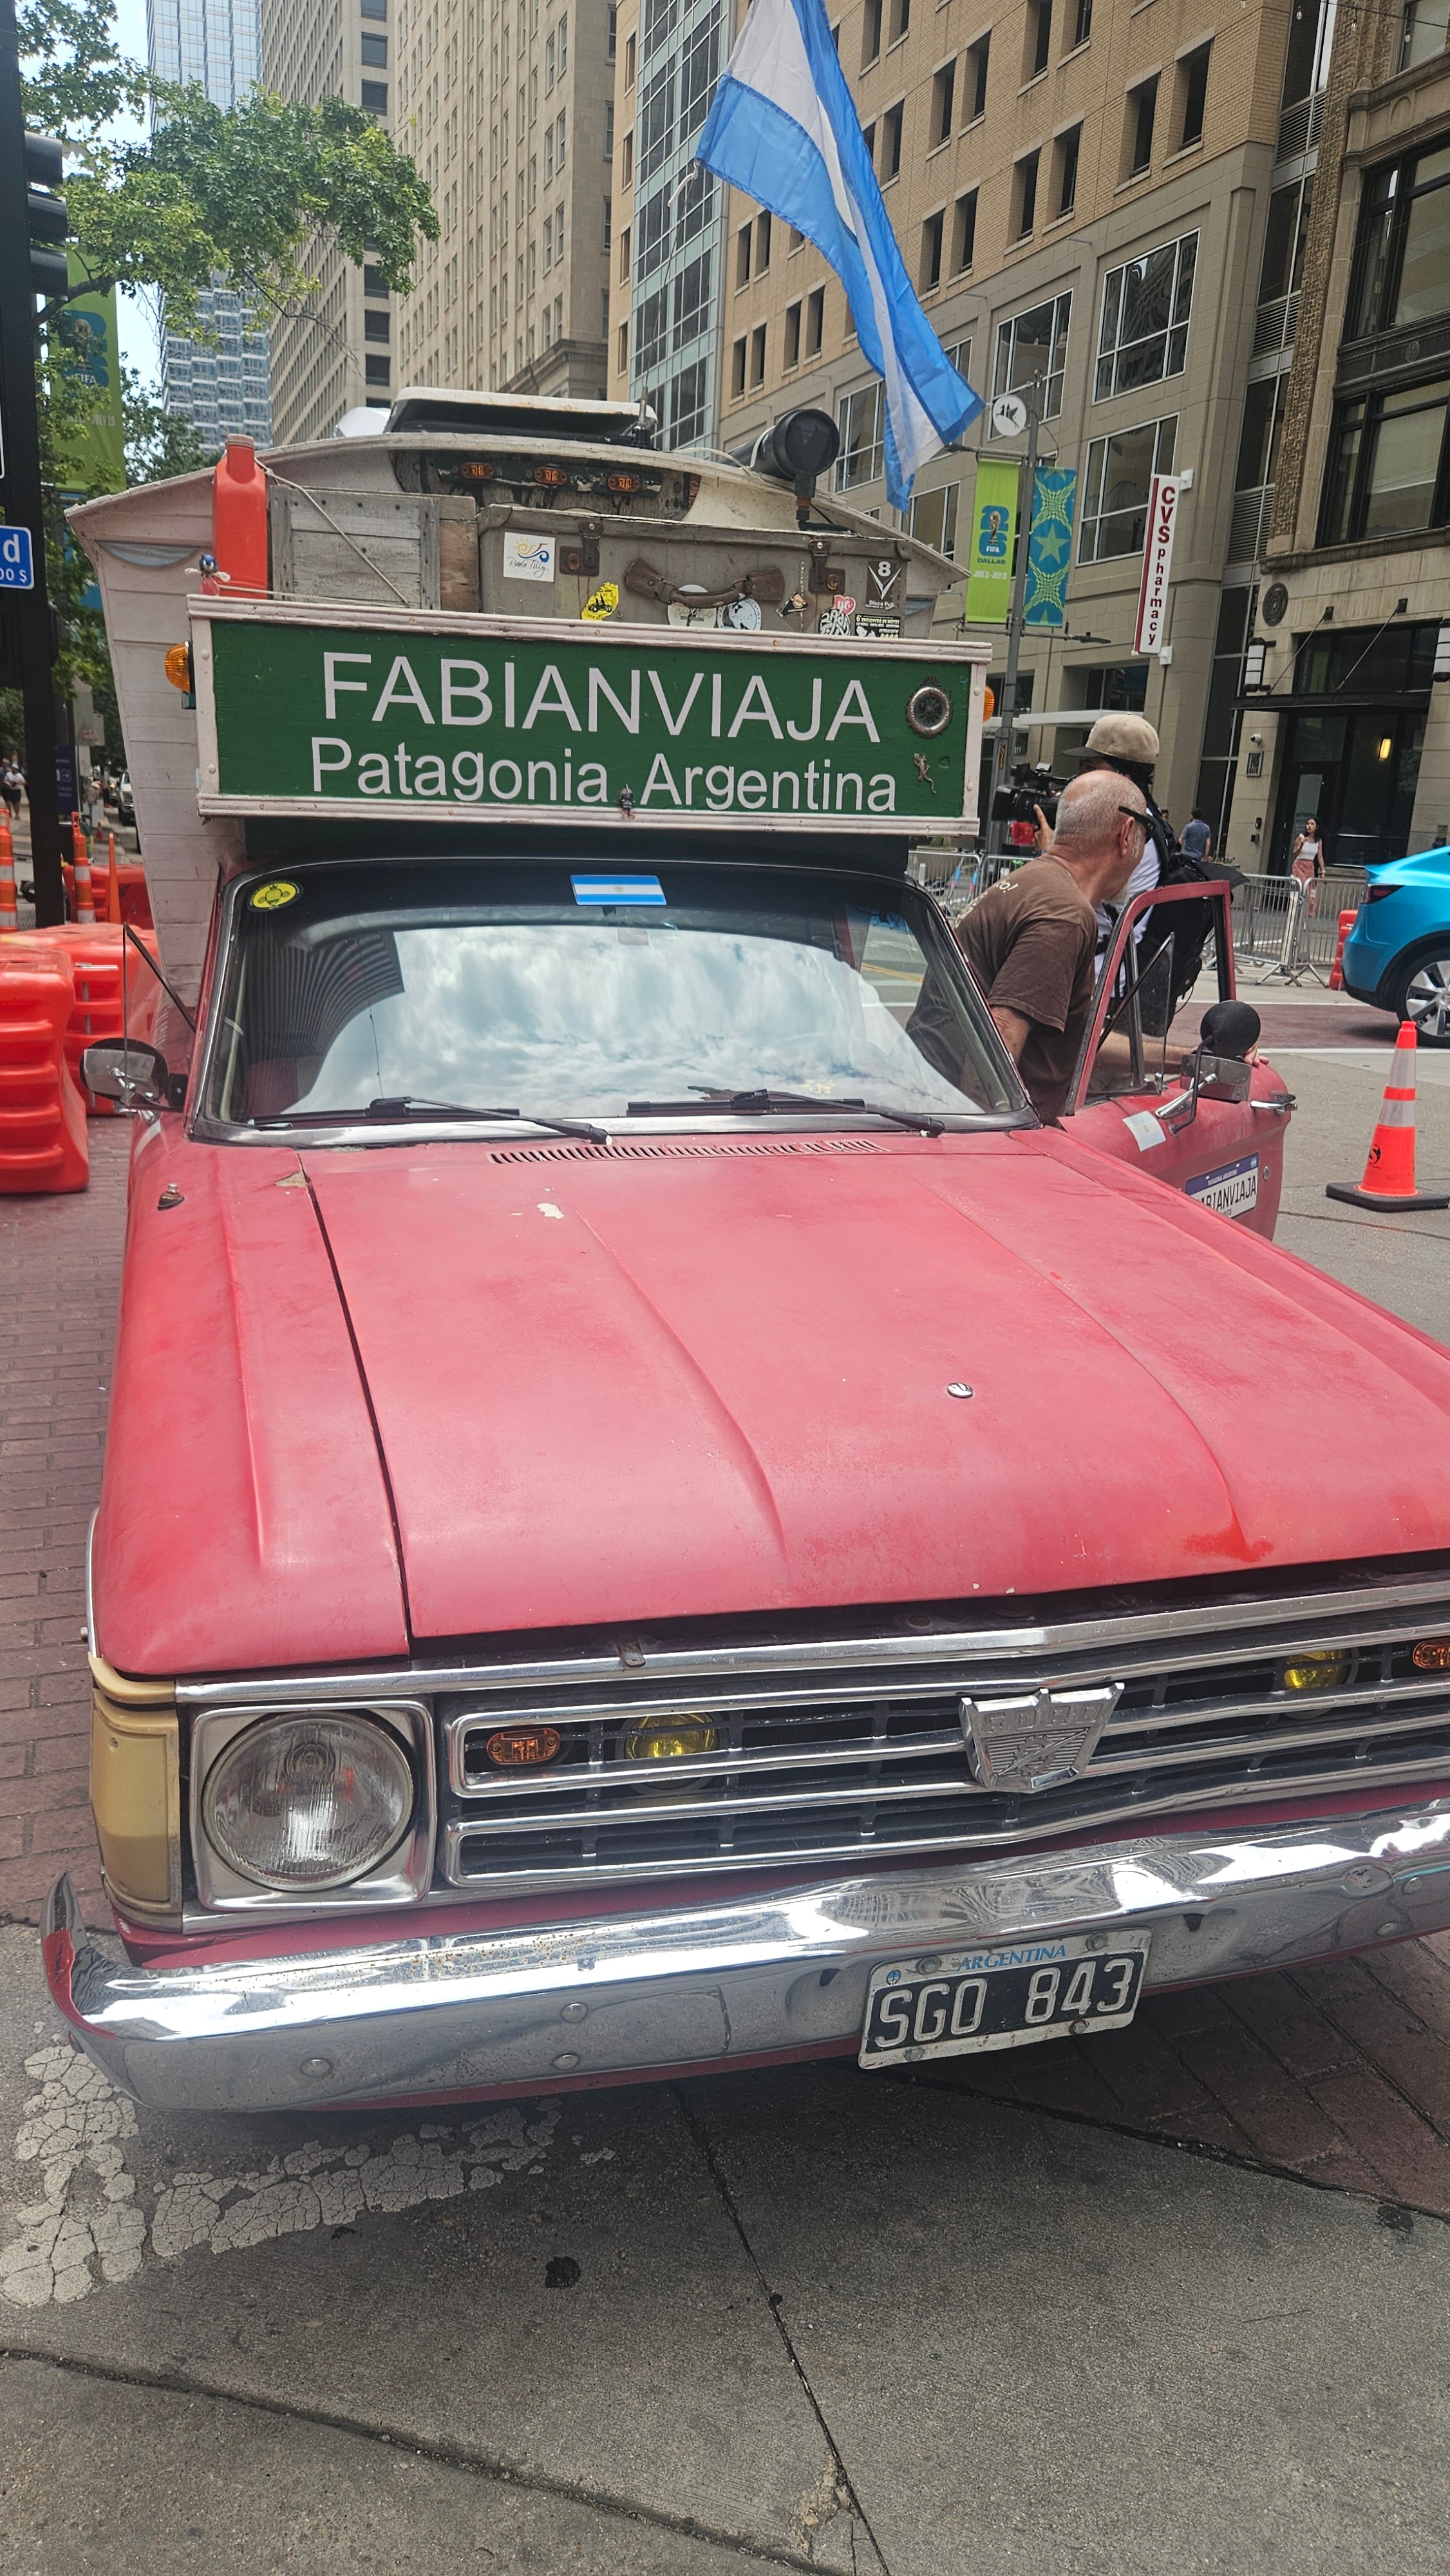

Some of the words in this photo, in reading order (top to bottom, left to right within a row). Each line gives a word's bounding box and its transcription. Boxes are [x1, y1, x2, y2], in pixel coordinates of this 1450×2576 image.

[1158, 486, 1176, 544] CVS
[0, 533, 21, 563] d
[528, 558, 549, 578] Tilly
[1148, 547, 1166, 645] pharmacy
[323, 652, 881, 743] FABIANVIAJA
[312, 737, 608, 802] Patagonia
[640, 753, 896, 812] Argentina
[984, 1702, 1104, 1734] FORD
[958, 1944, 1067, 1971] ARGENTINA
[874, 1977, 989, 2048] SGO
[1024, 1957, 1136, 2024] 843
